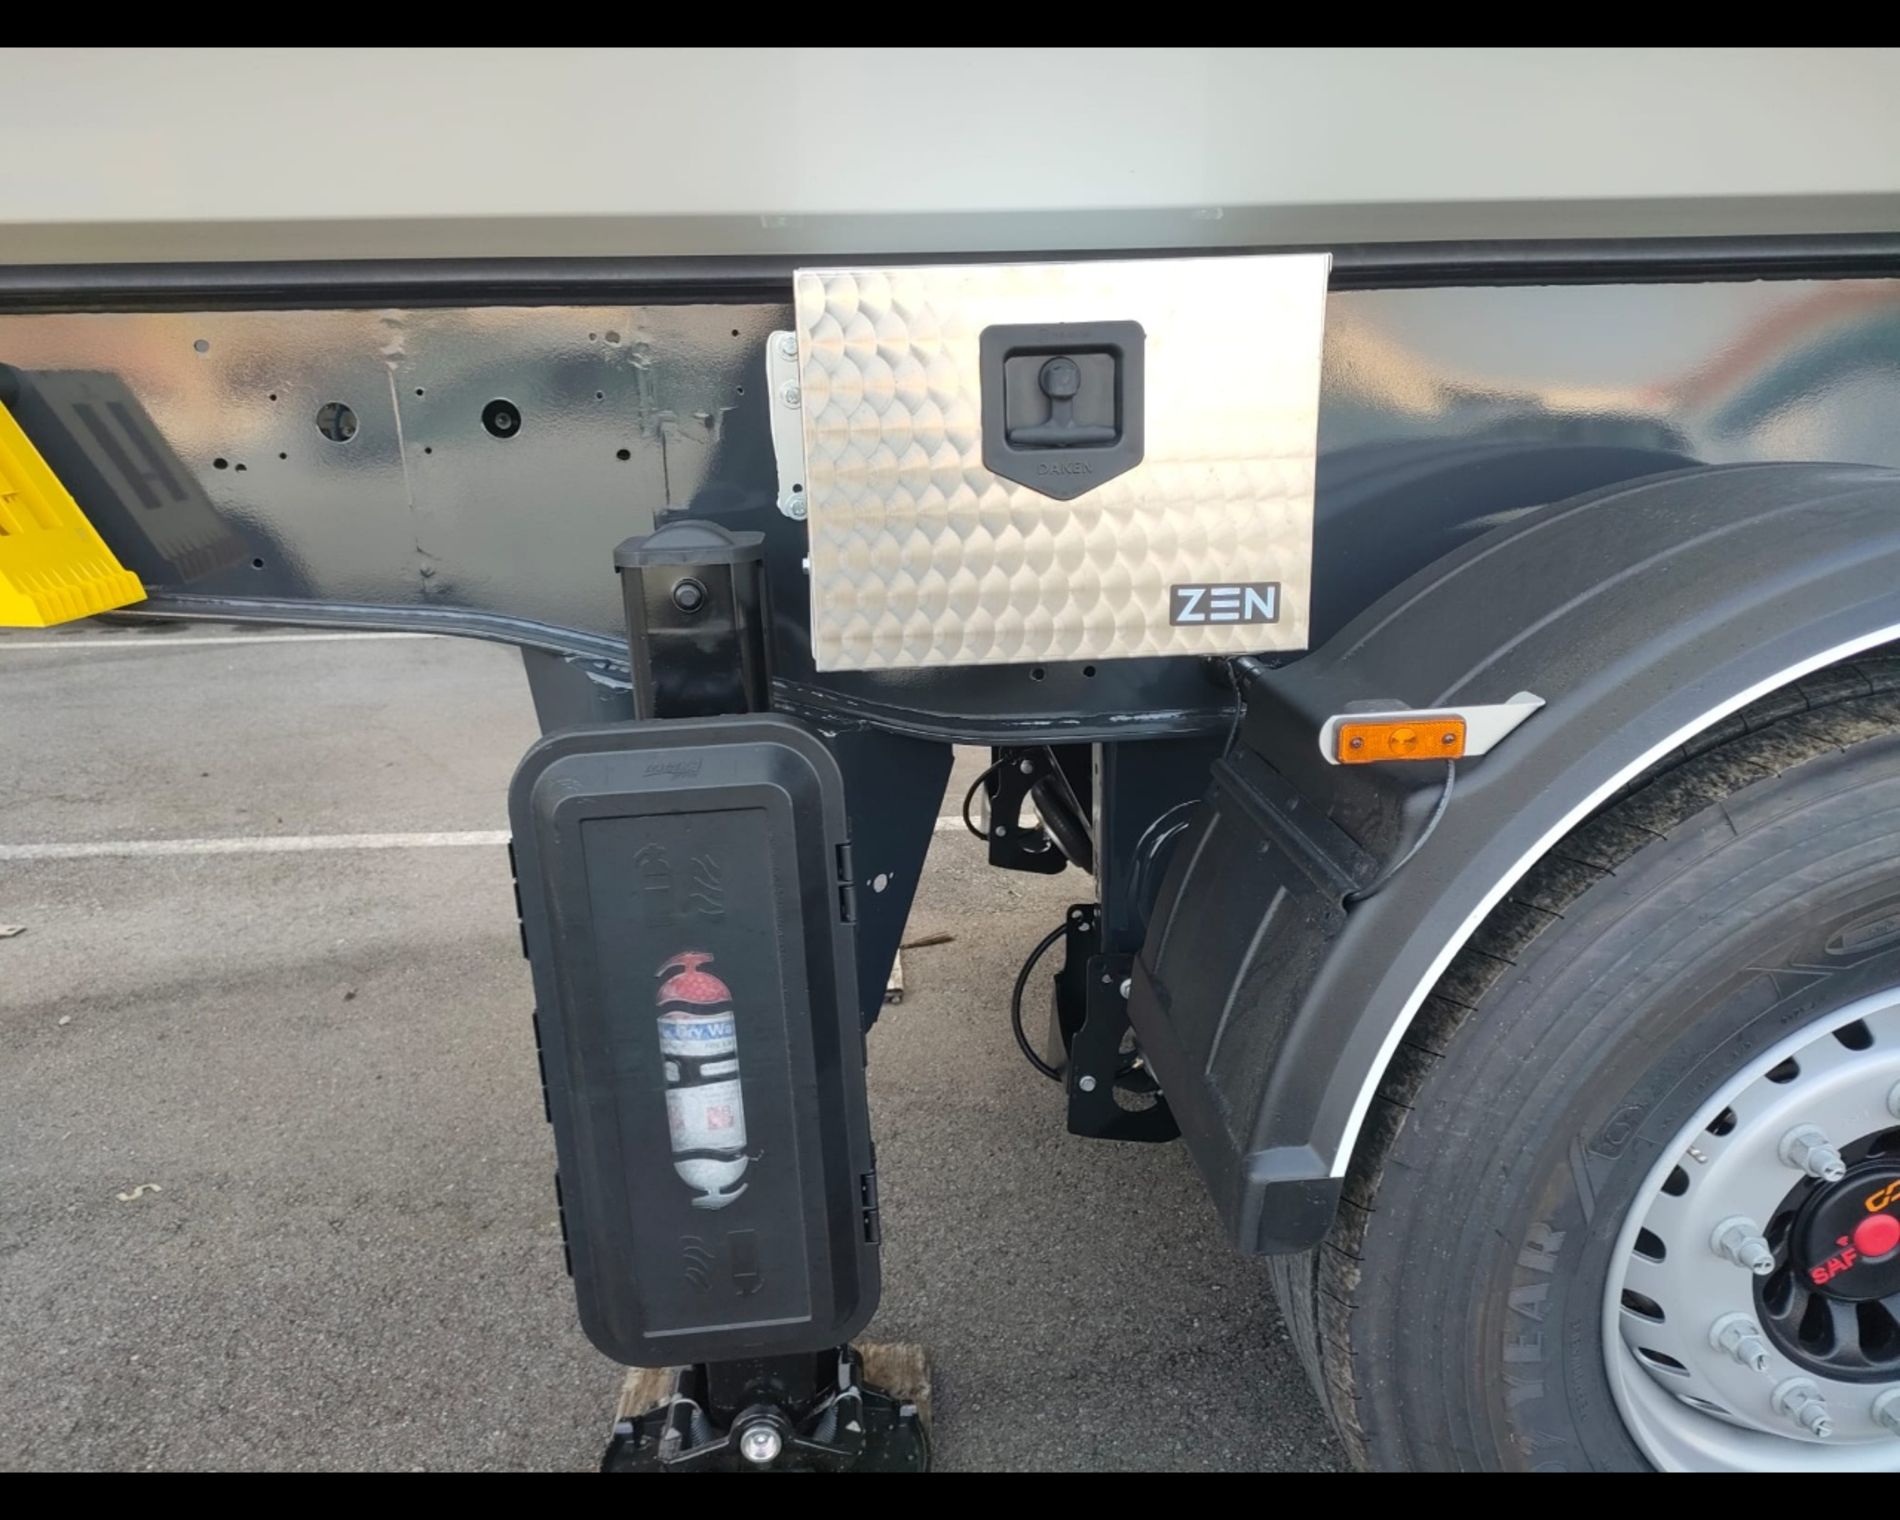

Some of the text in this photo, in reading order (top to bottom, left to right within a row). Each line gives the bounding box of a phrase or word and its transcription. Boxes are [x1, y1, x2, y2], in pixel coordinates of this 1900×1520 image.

[1037, 461, 1094, 477] DAKEN
[1175, 586, 1276, 622] ZEN
[1809, 1247, 1858, 1286] SAF
